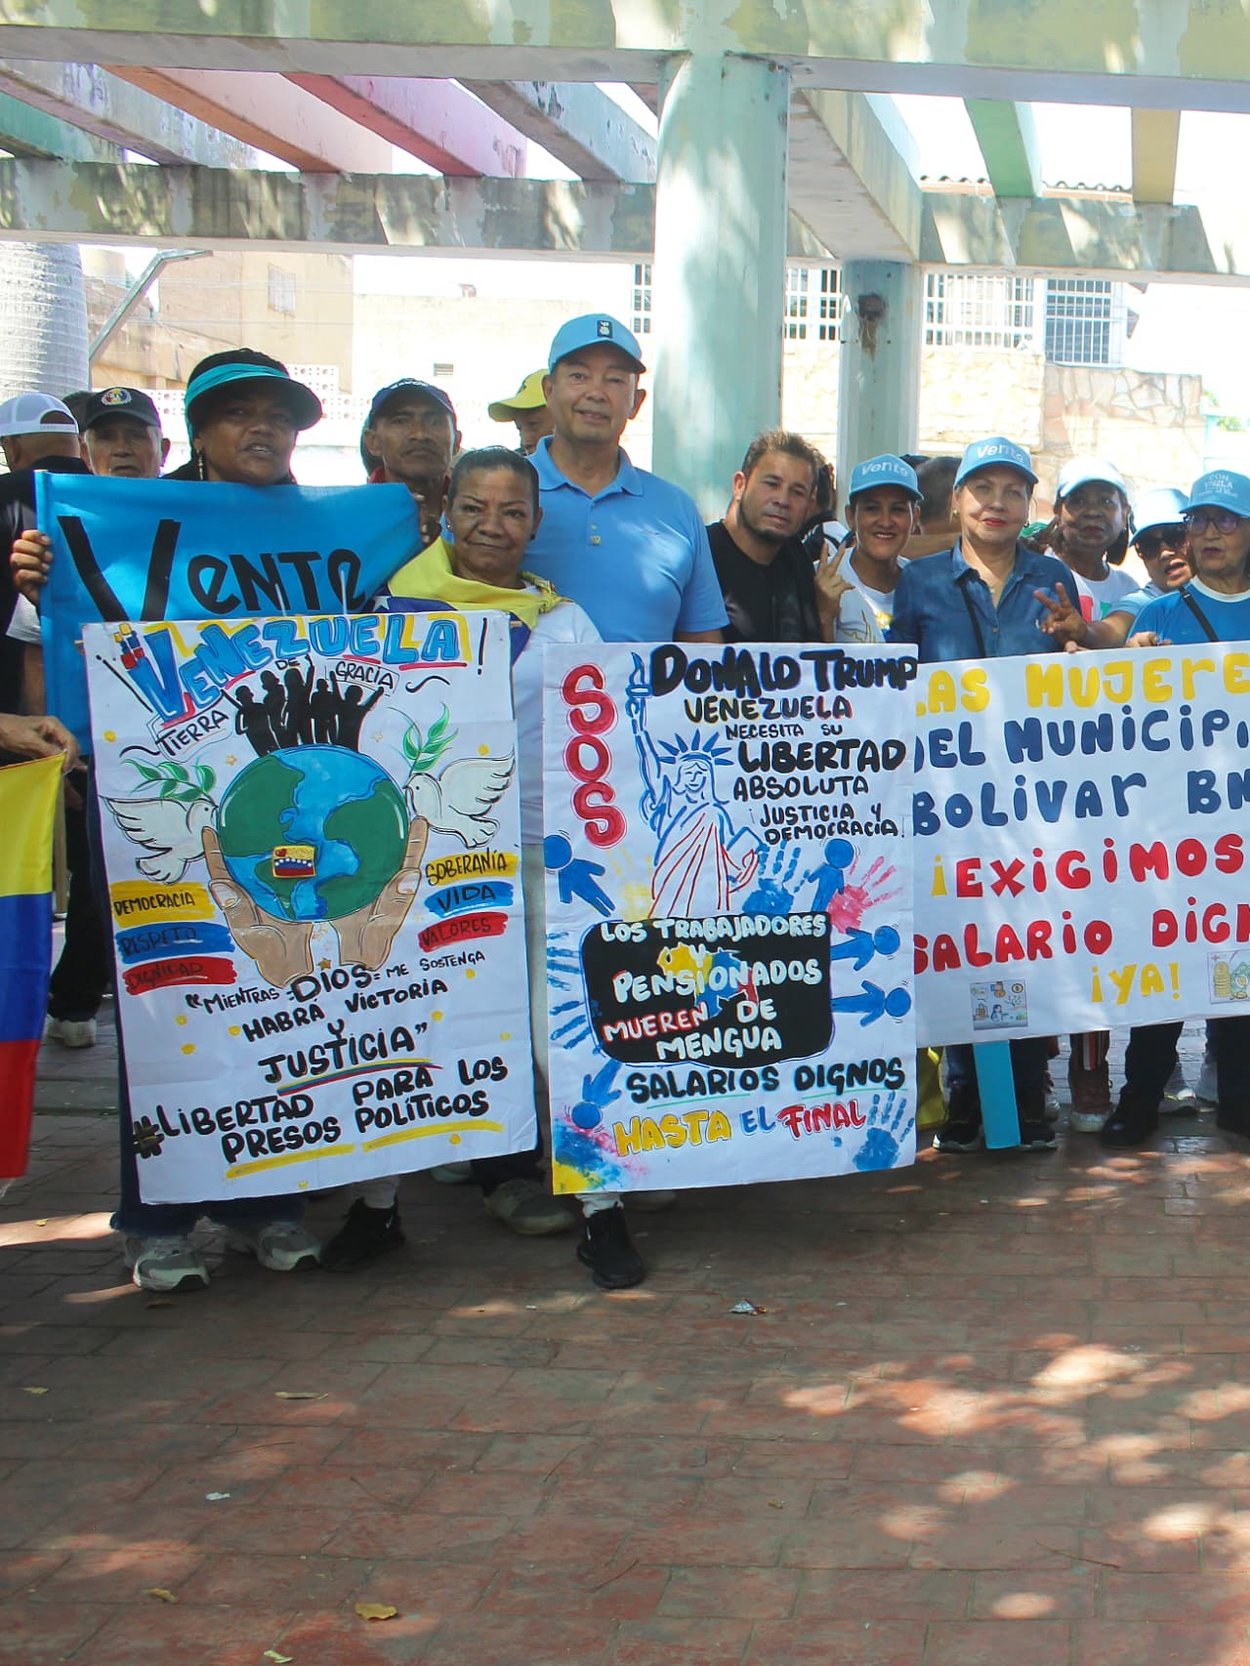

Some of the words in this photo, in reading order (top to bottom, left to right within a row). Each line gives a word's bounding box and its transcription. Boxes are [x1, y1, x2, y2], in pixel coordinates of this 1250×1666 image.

[800, 649, 918, 693] TRUMP
[157, 709, 229, 757] TIERRA
[275, 658, 300, 671] DE
[336, 661, 394, 689] GRACIA
[684, 695, 853, 723] VENEZUELA
[916, 668, 991, 717] AS
[725, 724, 804, 741] NECESITA
[821, 724, 843, 738] SU
[737, 740, 906, 774] LIBERTAD
[733, 776, 869, 801] ABSOLUTA
[113, 890, 196, 916] DEMOCRACIA
[437, 885, 496, 912] VIDA
[121, 927, 198, 957] RESPETO
[421, 918, 491, 946] VALORES
[601, 921, 648, 943] LOS
[652, 914, 827, 942] TRABAJADORES
[387, 964, 409, 978] ME
[419, 950, 485, 972] SOSTENGA
[613, 959, 823, 1003] PENSIONADOS
[602, 1002, 709, 1043] MUEREN
[736, 999, 777, 1024] DE
[656, 1026, 782, 1062] MENGUA
[352, 1067, 433, 1105] PARA
[458, 1056, 508, 1086] LOS
[626, 1066, 780, 1104] SALARIOS
[794, 1057, 905, 1095] DIGNOS
[222, 1116, 341, 1165] PRESOS
[613, 1110, 732, 1158] HASTA
[740, 1105, 776, 1136] EL
[777, 1098, 868, 1142] FINAL
